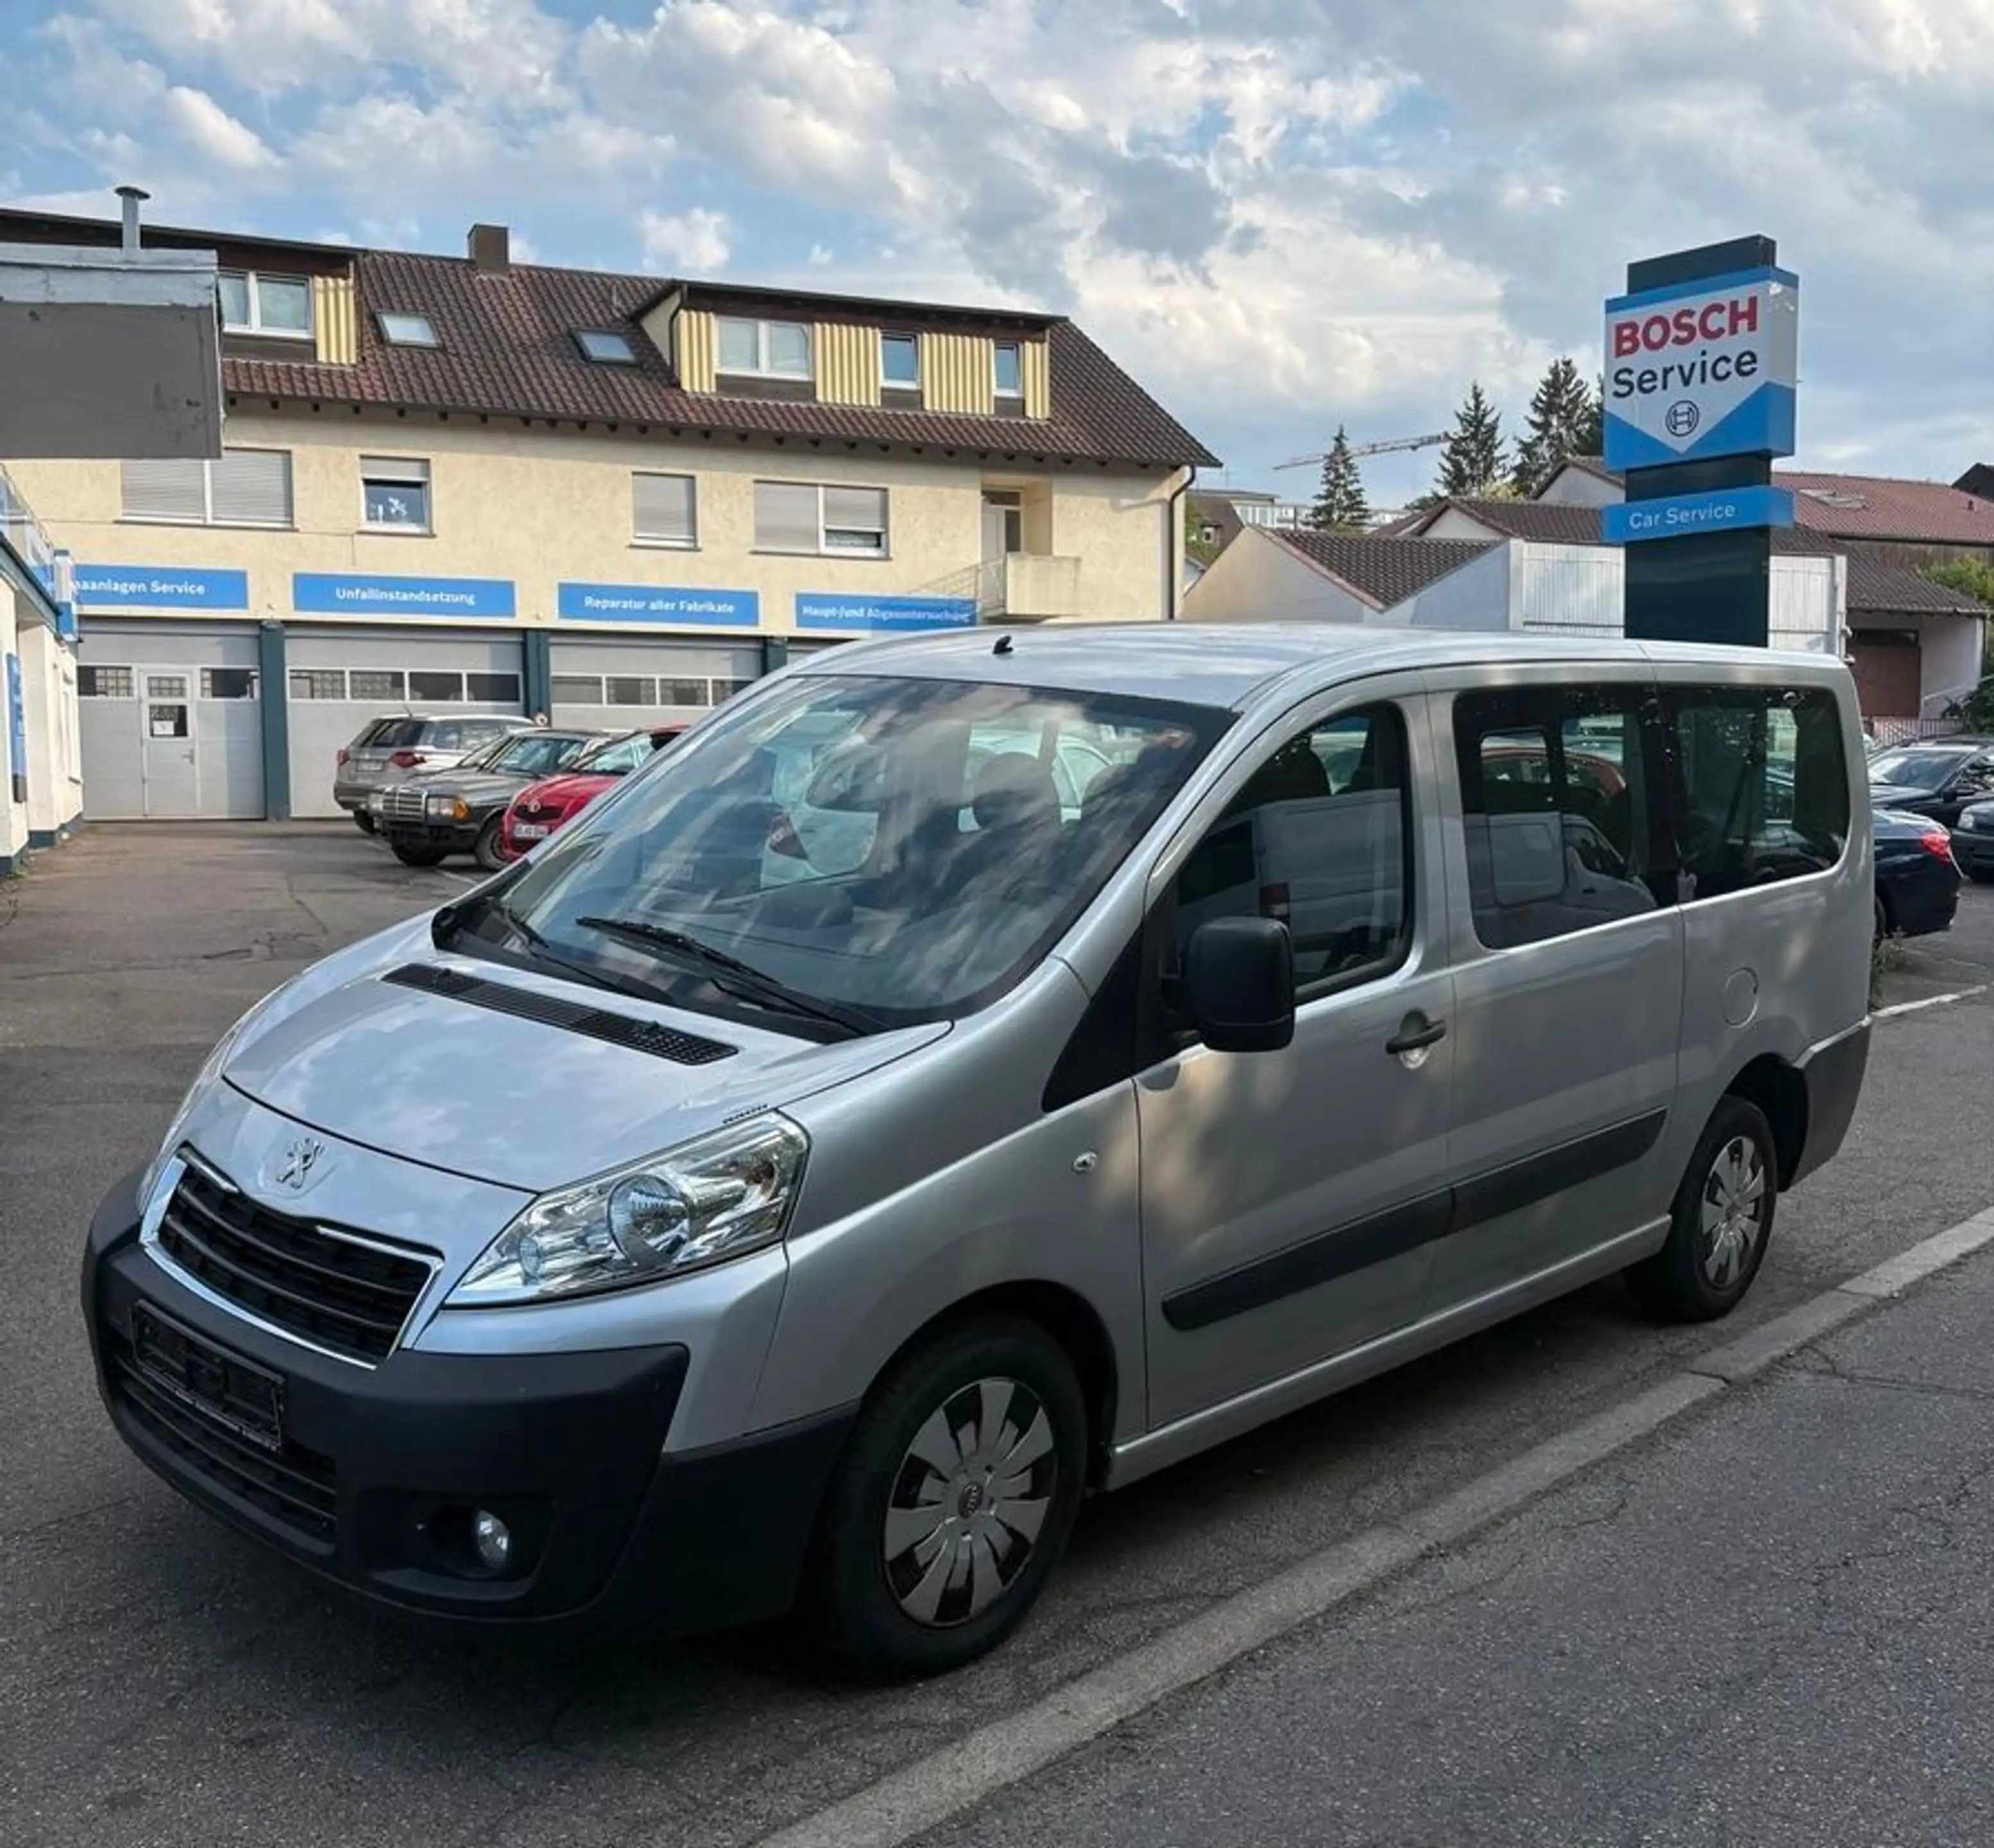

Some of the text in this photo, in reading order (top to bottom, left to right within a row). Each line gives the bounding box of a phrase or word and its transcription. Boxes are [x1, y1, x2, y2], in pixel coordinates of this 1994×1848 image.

[1614, 295, 1758, 359] BOSCH
[1612, 349, 1758, 398] Service
[1629, 502, 1735, 530] Car Service
[151, 579, 205, 595] Service
[584, 595, 735, 613] Reparatur aller Fabrikate
